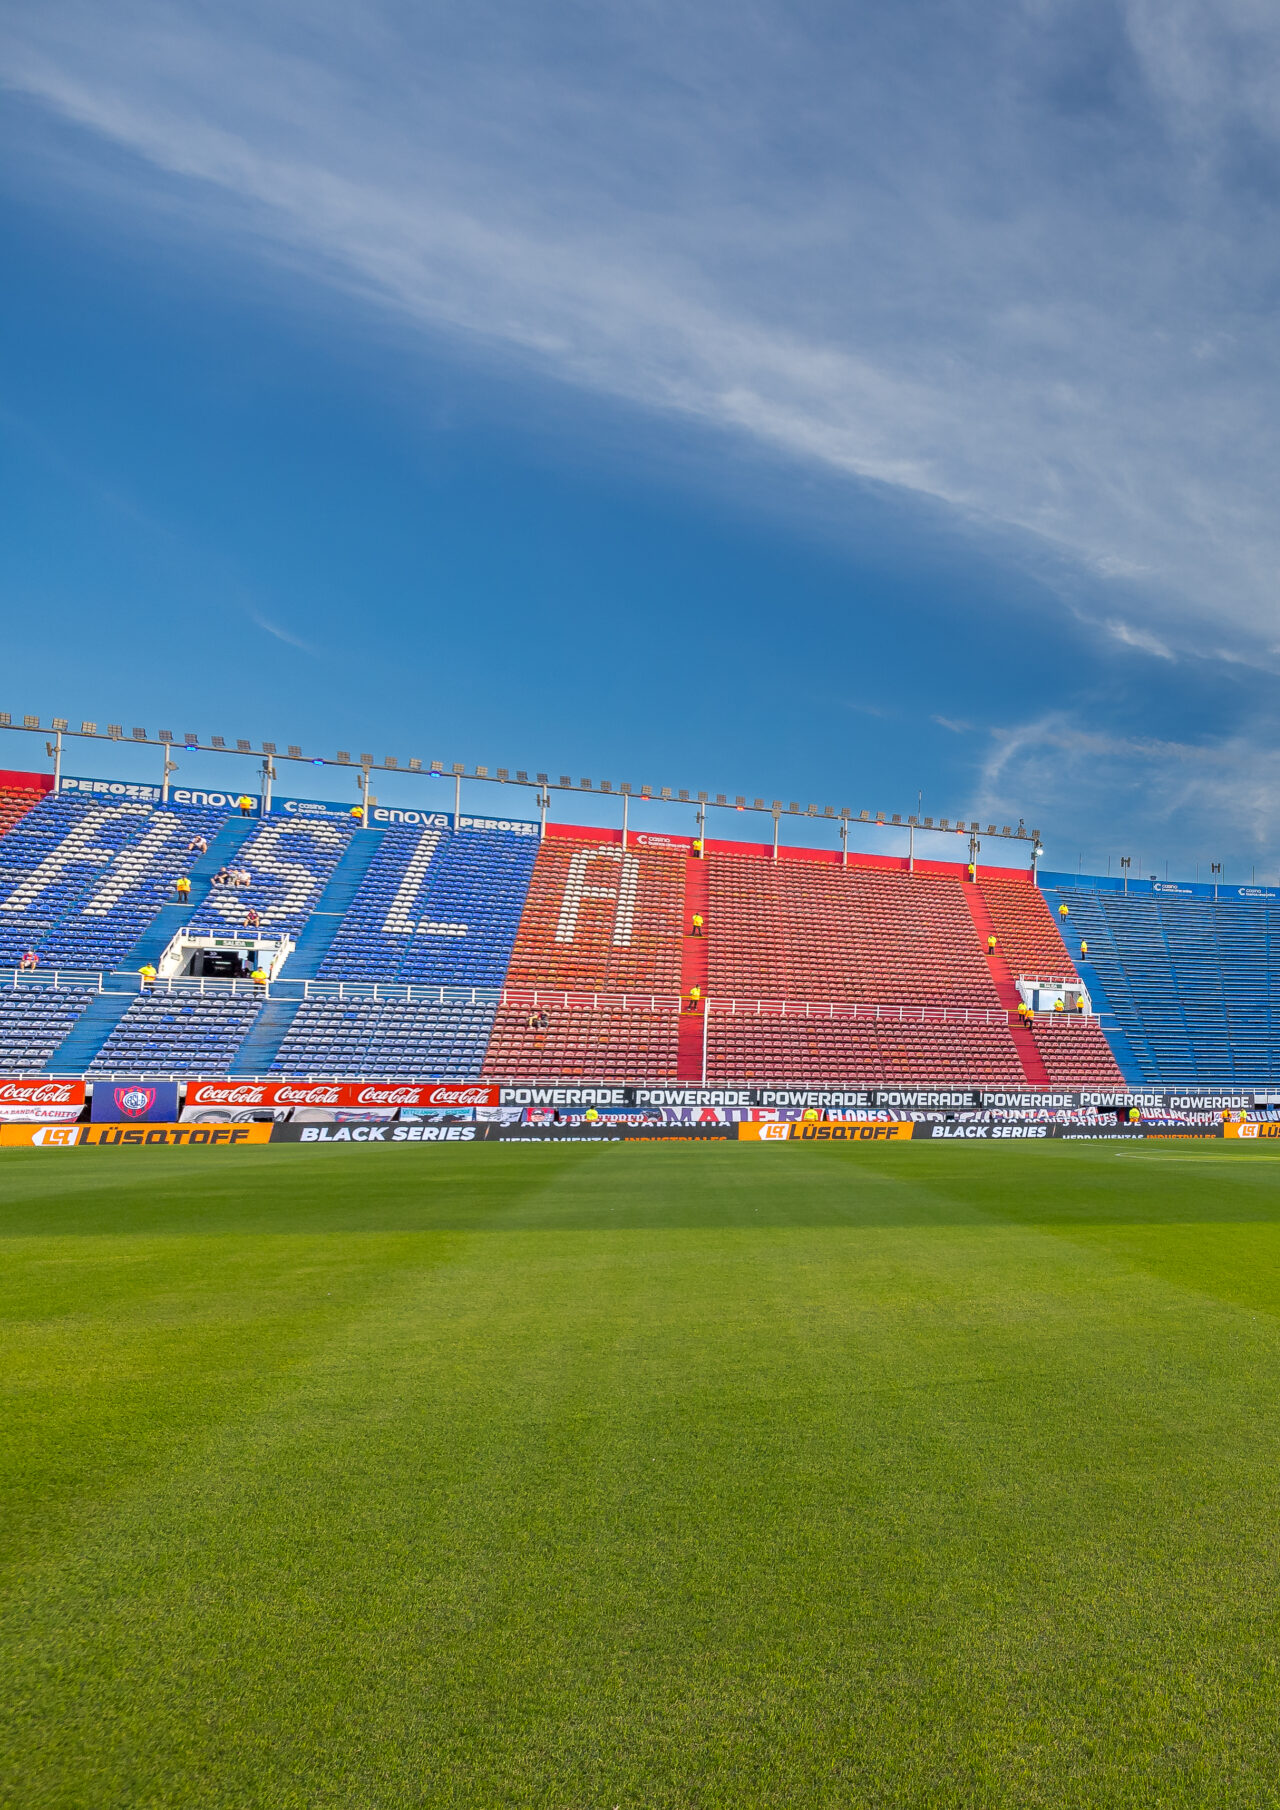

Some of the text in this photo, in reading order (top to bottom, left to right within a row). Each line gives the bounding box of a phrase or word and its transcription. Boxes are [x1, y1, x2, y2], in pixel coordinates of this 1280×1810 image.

[61, 778, 161, 799] PEROZZI
[374, 808, 448, 827] enova
[459, 817, 539, 834] PEROZZI
[0, 1084, 76, 1102] Coca-Cola
[195, 1085, 267, 1103] Coca-Cola
[274, 1085, 343, 1104] Coca-Cola
[357, 1086, 423, 1104] Coca-Cola
[430, 1087, 492, 1104] Coca-Cola
[992, 1108, 1051, 1119] PUNTA
[78, 1126, 249, 1145] LÜSQTOFF
[300, 1126, 476, 1142] BLACK SERIES
[789, 1124, 899, 1140] LÜSQTOFF
[931, 1126, 1047, 1138] BLACK SERIES
